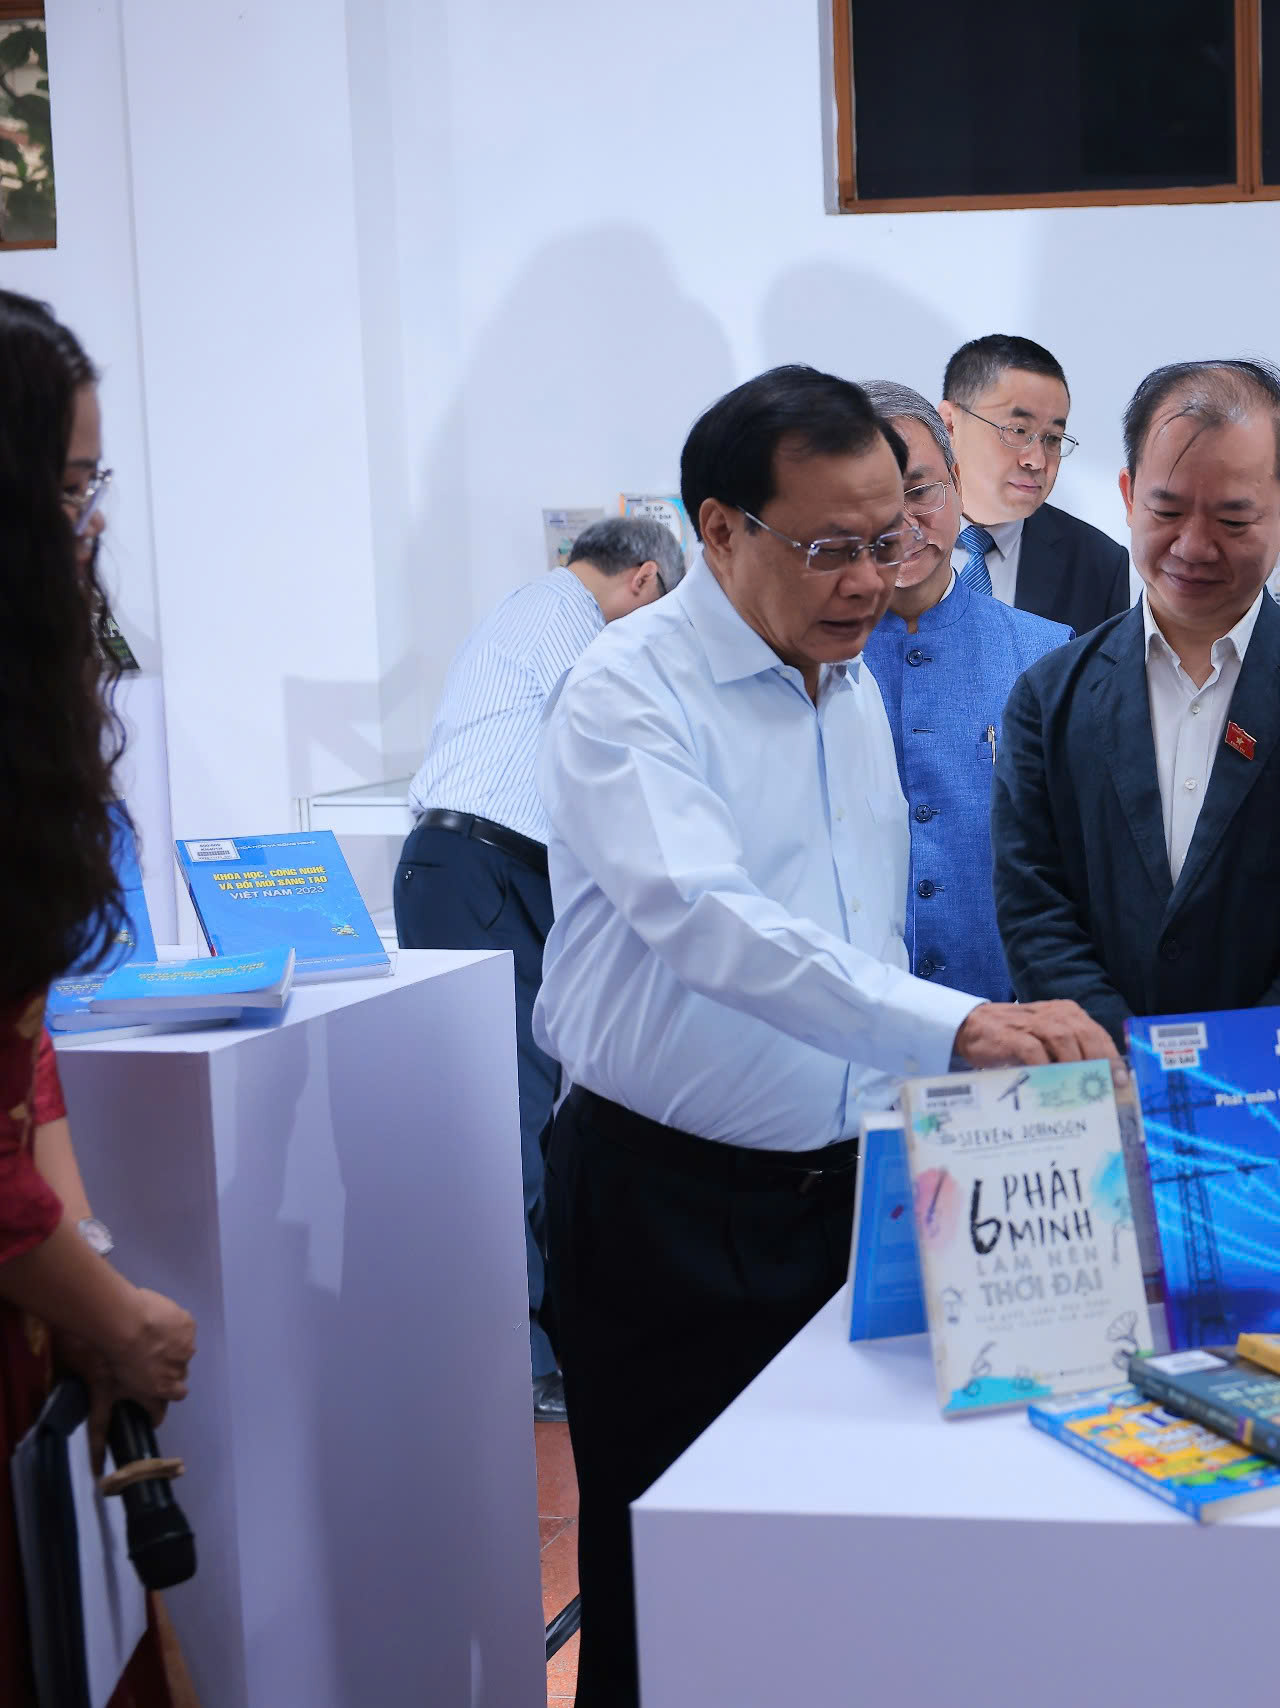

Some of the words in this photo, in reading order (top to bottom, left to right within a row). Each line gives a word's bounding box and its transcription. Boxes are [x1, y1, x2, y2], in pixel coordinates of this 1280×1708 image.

[213, 873, 241, 881] KHOA
[229, 890, 260, 900] VIỆT
[262, 888, 293, 897] NAM
[295, 885, 326, 895] 2023
[1003, 1160, 1083, 1214] PHÁT
[970, 1179, 1002, 1255] 6
[1007, 1208, 1093, 1252] MINH
[1051, 1266, 1104, 1298] ĐẠI
